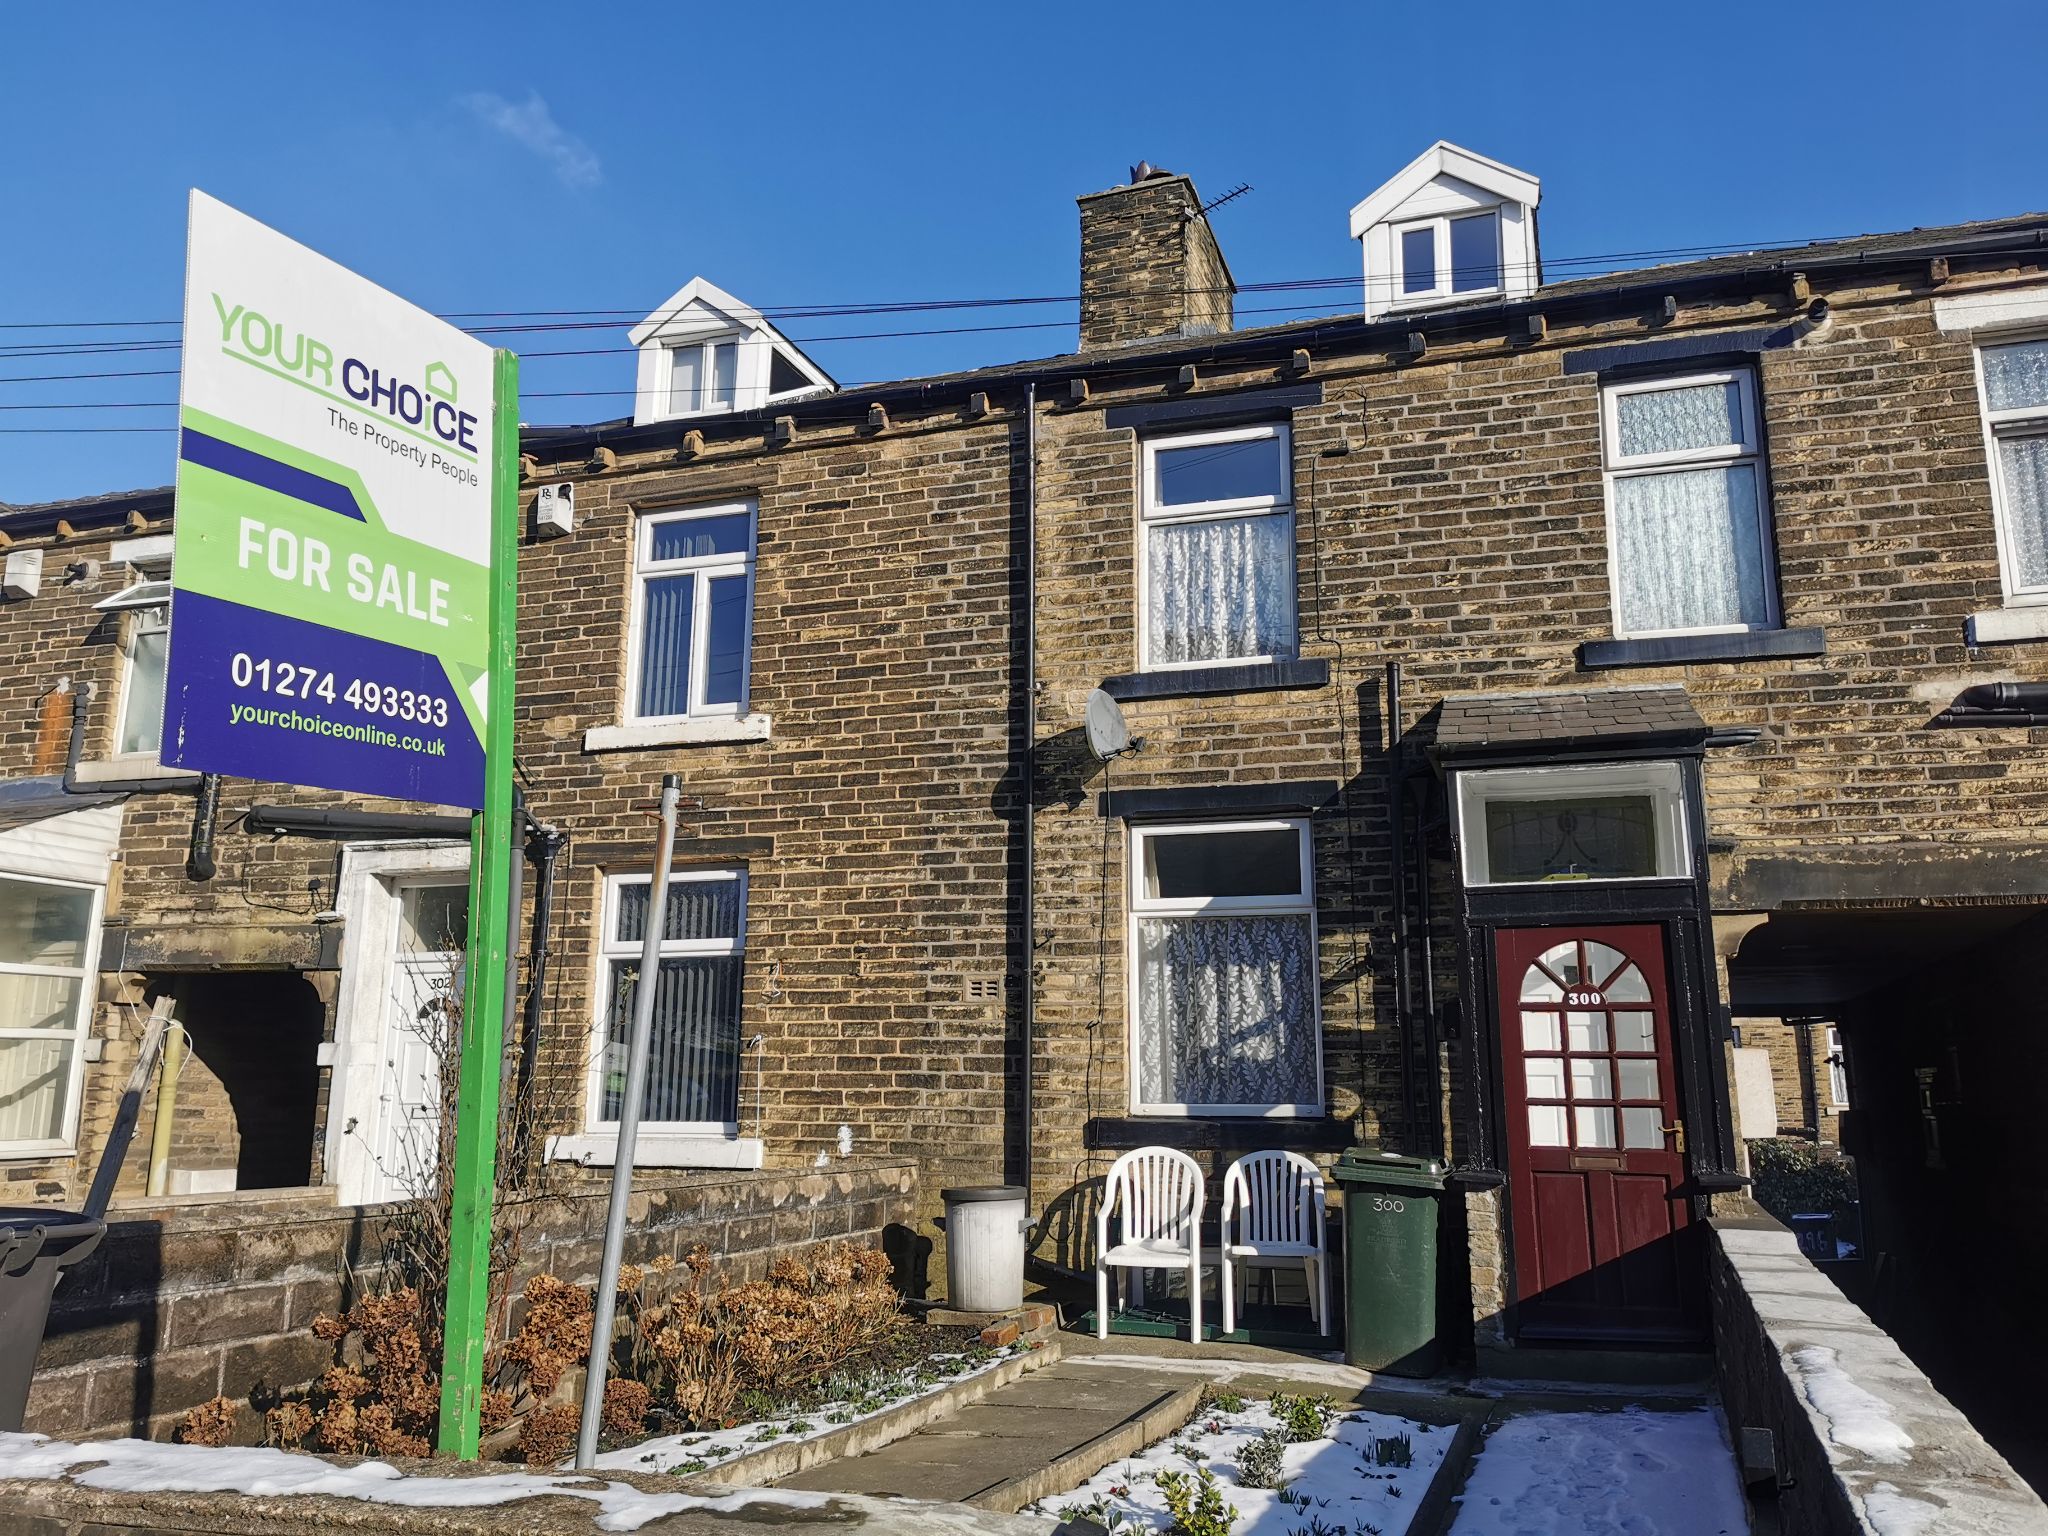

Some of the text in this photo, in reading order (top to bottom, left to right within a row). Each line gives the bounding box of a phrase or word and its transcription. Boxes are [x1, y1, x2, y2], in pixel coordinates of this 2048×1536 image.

[211, 292, 334, 387] YOUR
[327, 407, 479, 487] The Property People
[238, 516, 450, 627] FOR SALE
[231, 652, 448, 727] 01274 493333
[229, 703, 446, 757] yourchoiceonline.co.uk
[1569, 993, 1600, 1005] 300
[1373, 1198, 1404, 1212] 300
